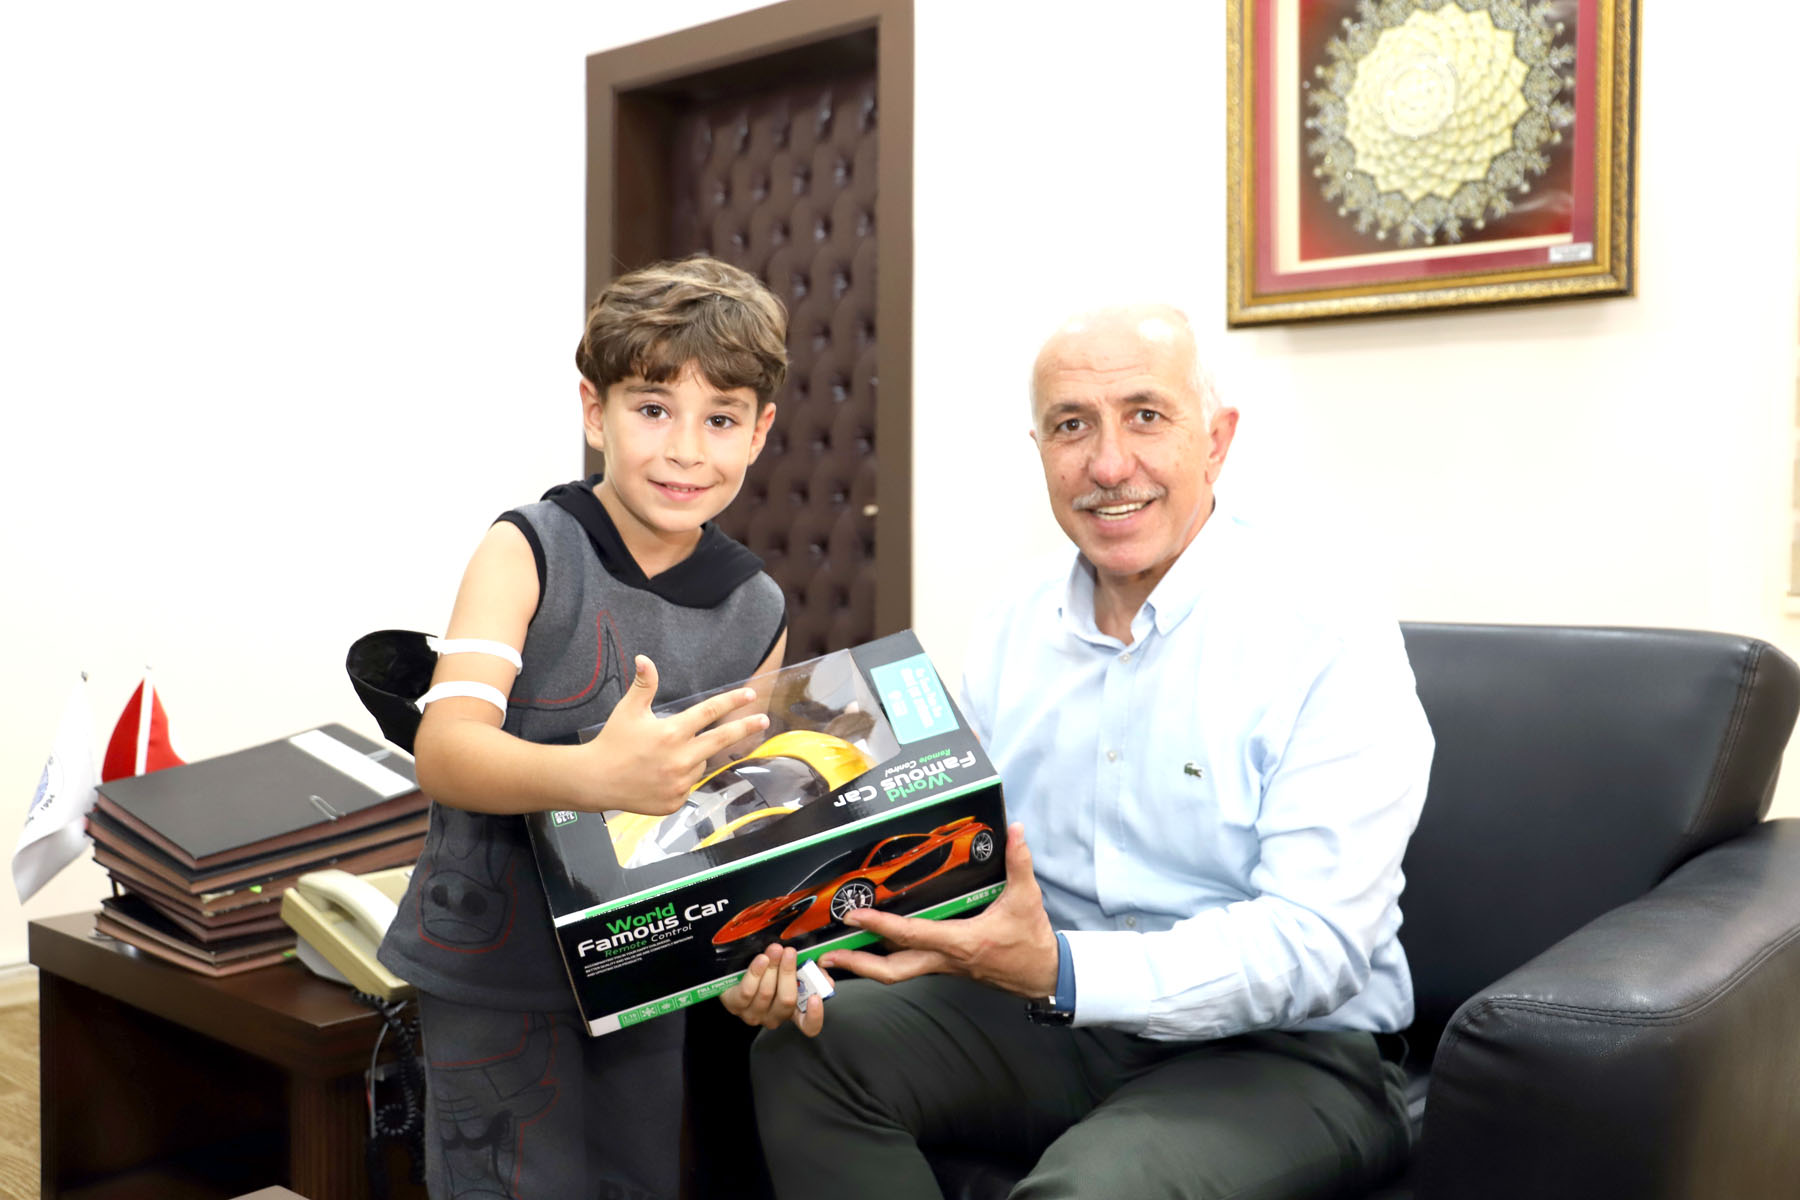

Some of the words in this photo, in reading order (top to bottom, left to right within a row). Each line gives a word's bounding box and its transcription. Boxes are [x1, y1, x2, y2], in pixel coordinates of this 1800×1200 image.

[880, 750, 977, 791] Famous
[884, 760, 917, 778] Control
[919, 748, 951, 763] Remote
[833, 785, 878, 807] Car
[885, 772, 953, 802] World
[966, 890, 989, 904] AGES
[578, 915, 680, 958] Famous
[684, 899, 729, 921] Car
[606, 902, 676, 934] World
[604, 939, 648, 958] Remote
[651, 923, 692, 943] Control
